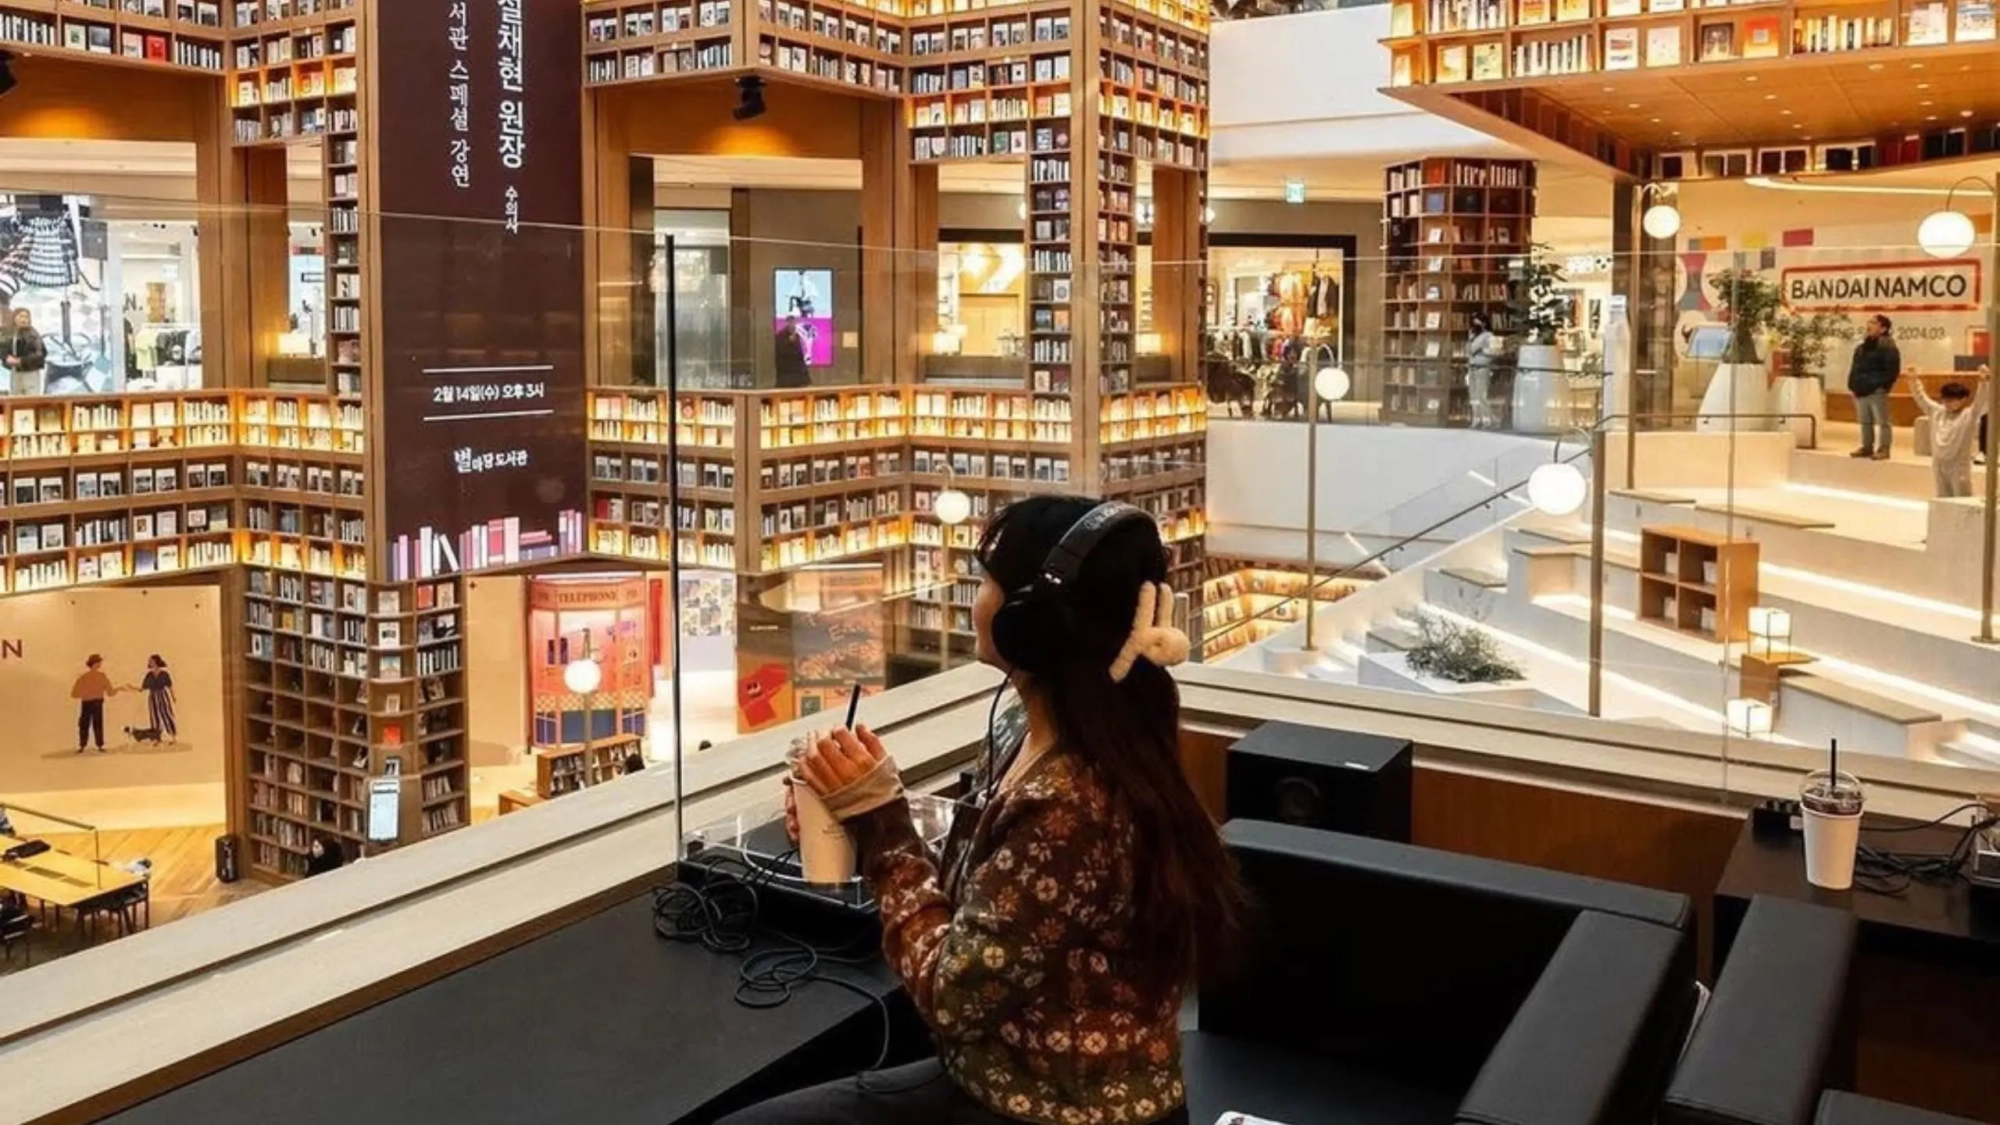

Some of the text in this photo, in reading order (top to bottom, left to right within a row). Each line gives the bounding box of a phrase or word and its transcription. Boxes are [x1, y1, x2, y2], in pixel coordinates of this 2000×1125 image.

[450, 60, 469, 131] 스페셜
[498, 101, 525, 168] 원장
[451, 139, 470, 187] 강연
[505, 186, 518, 234] 수의사
[1791, 274, 1967, 300] BANDAI NAMCO
[502, 383, 524, 399] 오후
[526, 382, 544, 398] 3시
